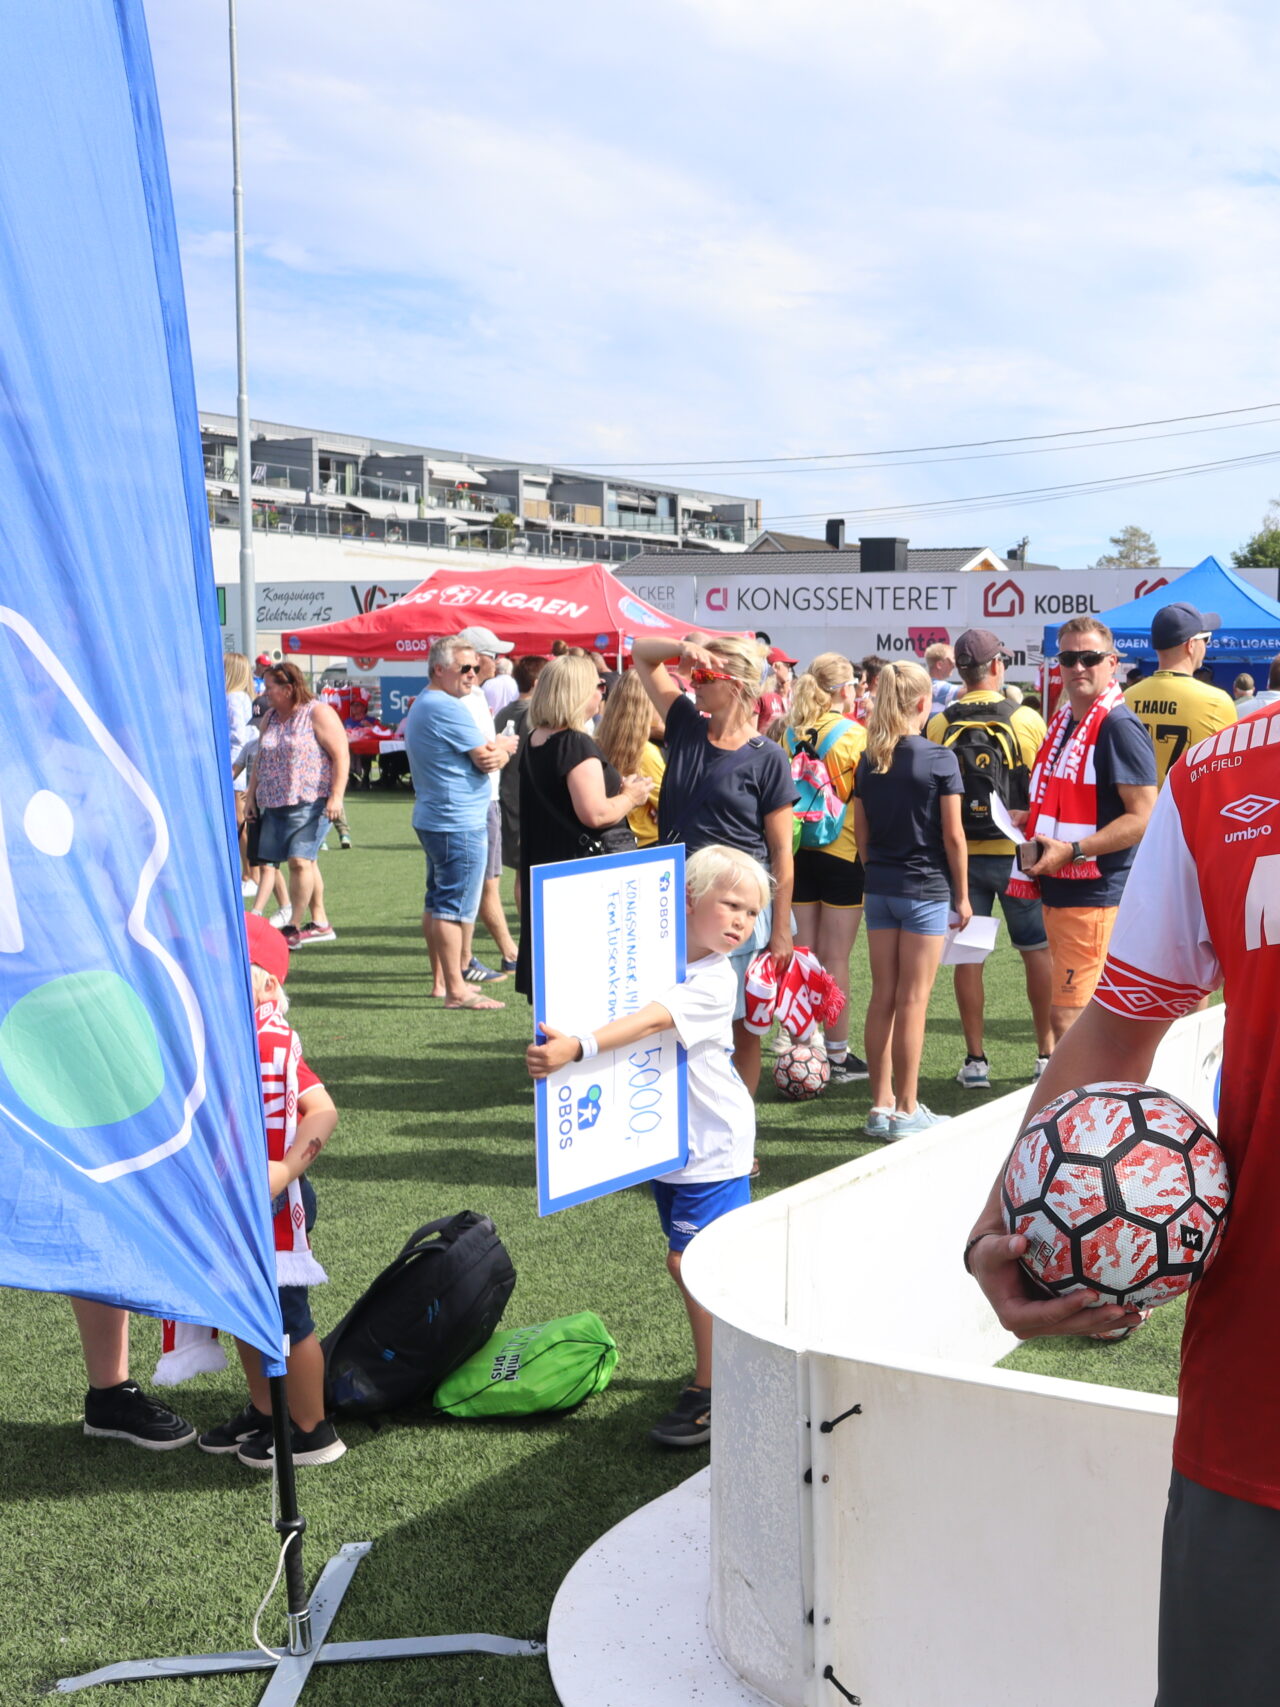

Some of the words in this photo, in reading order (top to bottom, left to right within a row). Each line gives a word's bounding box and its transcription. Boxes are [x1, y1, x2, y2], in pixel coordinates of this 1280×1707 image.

[262, 587, 325, 605] Kongsvinger
[475, 589, 590, 618] LIGAEN
[737, 586, 958, 611] KONGSSENTERET
[1034, 594, 1100, 614] KOBBL
[256, 606, 307, 623] Elektriske
[310, 606, 332, 622] AS
[396, 639, 427, 652] OBOS
[1112, 638, 1149, 649] IGAEN
[1133, 699, 1178, 715] T.HAUG
[1211, 755, 1243, 772] FJELD
[1224, 824, 1272, 843] umbro
[659, 896, 669, 939] OBOS
[1066, 968, 1075, 985] 7
[558, 1085, 573, 1150] OBOS
[491, 1354, 507, 1381] pris
[503, 1353, 521, 1383] mini
